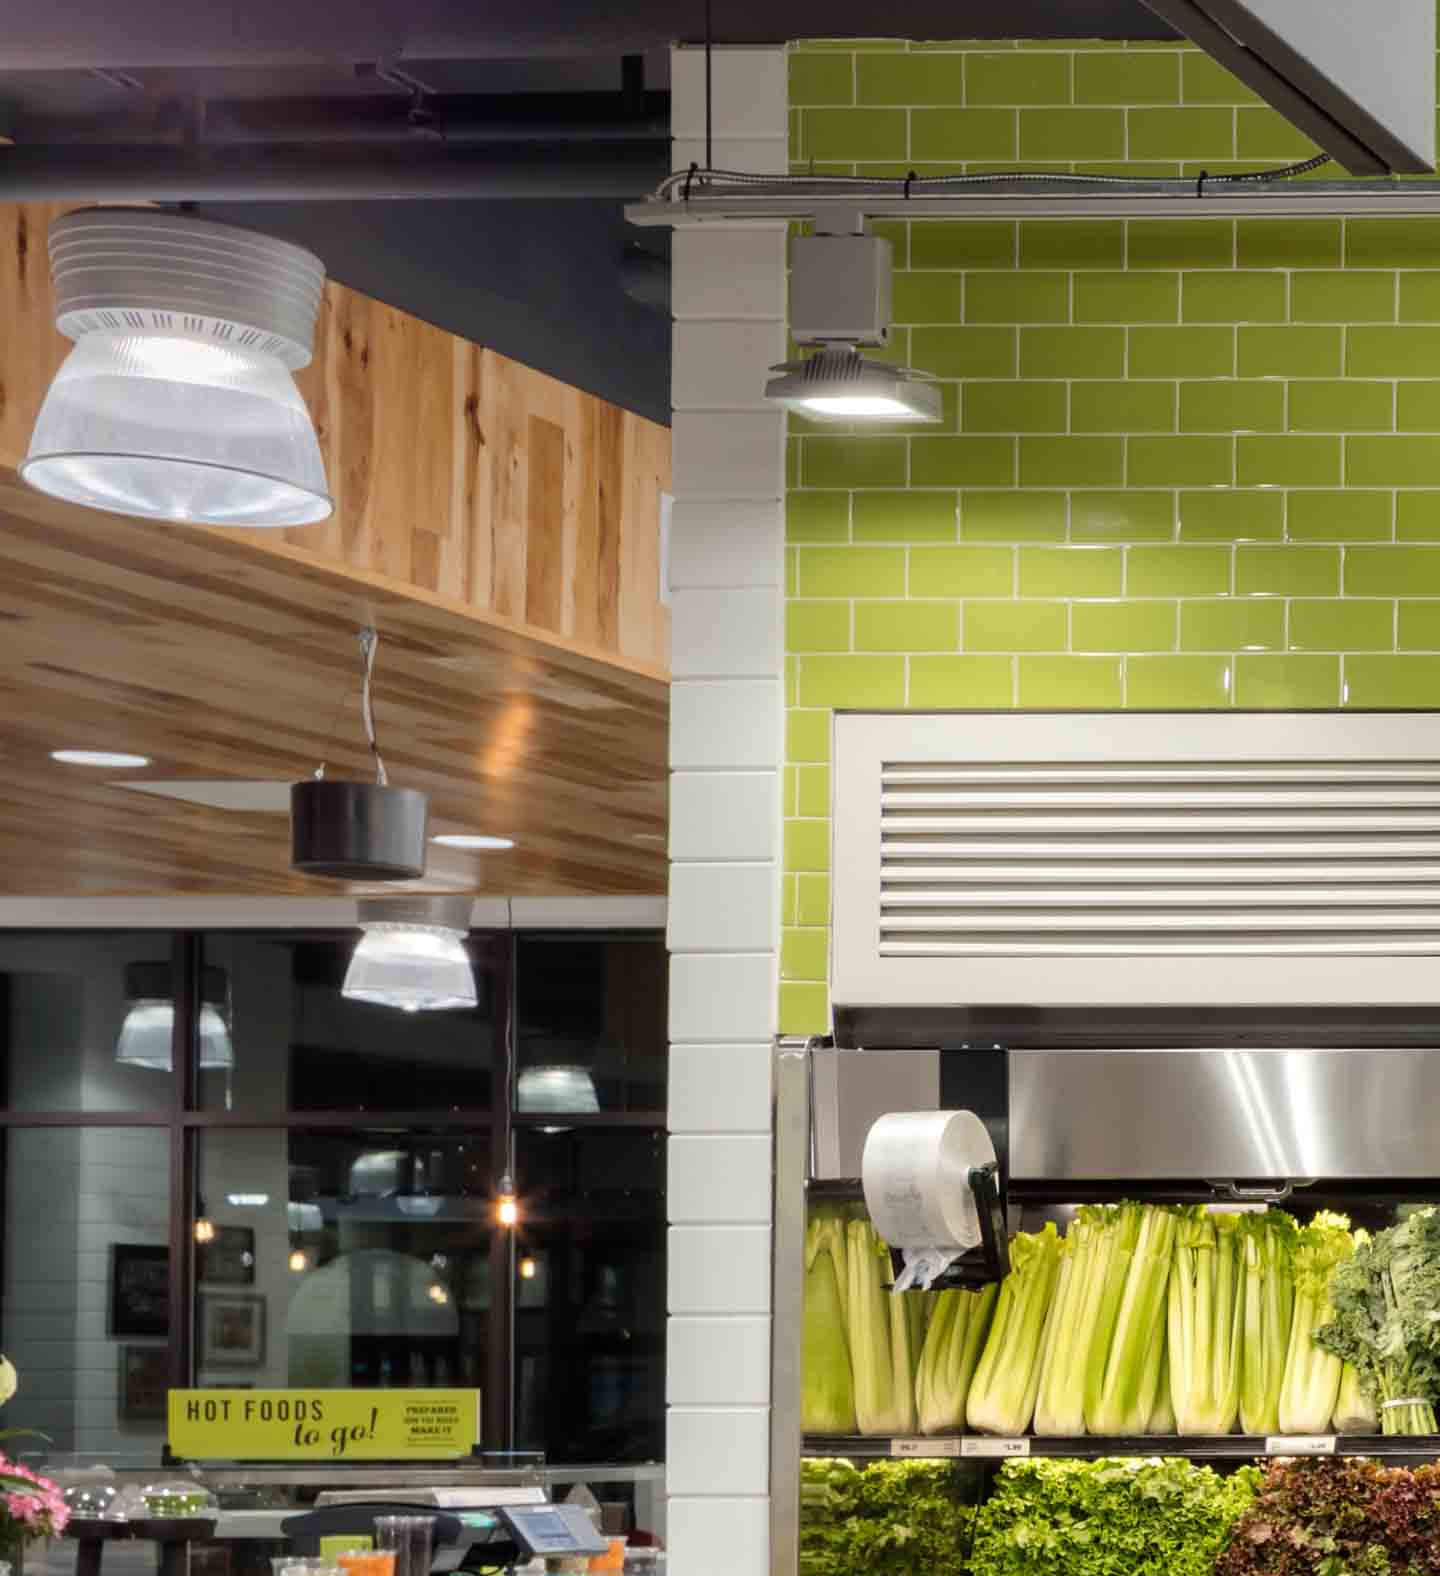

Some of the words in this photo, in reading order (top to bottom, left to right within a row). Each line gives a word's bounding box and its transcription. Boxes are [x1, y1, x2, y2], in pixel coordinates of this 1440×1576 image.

[186, 1399, 232, 1422] HOT
[244, 1399, 324, 1422] FOODS
[293, 1423, 319, 1447] to
[331, 1407, 379, 1456] go!
